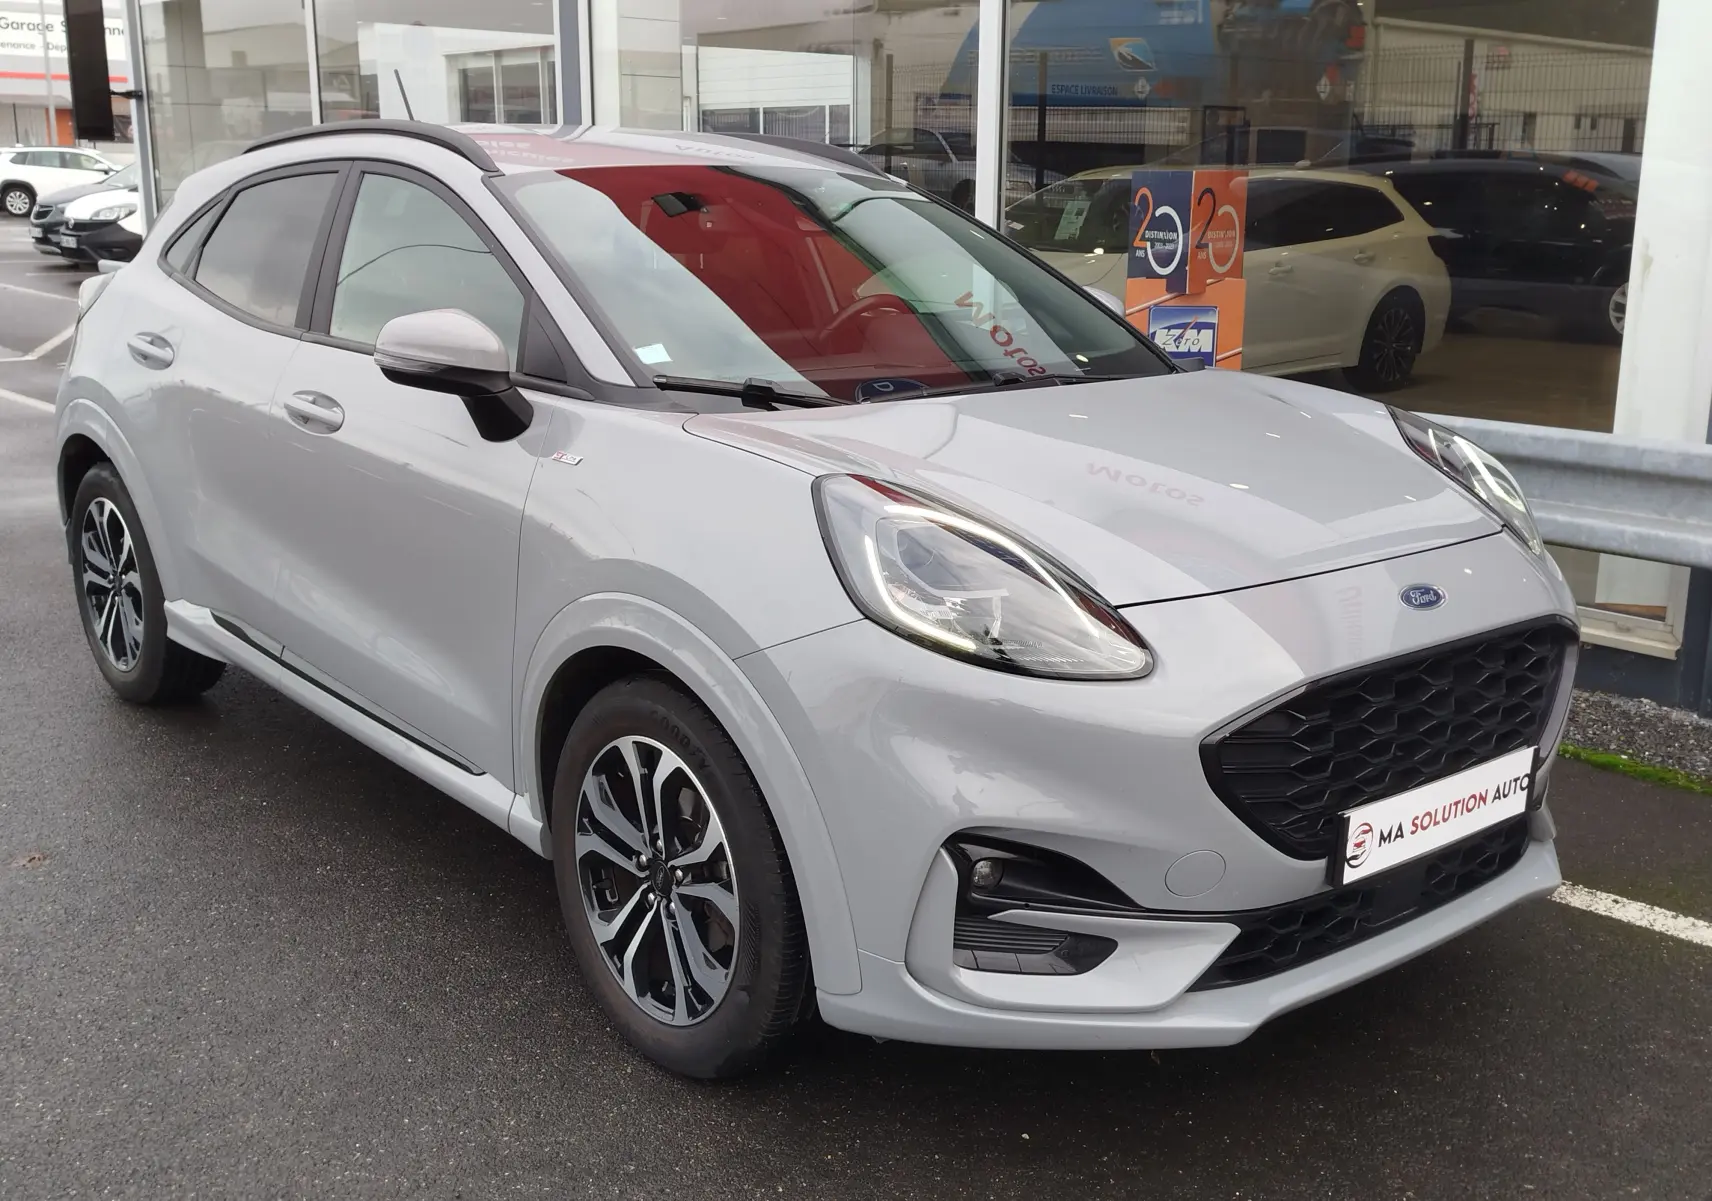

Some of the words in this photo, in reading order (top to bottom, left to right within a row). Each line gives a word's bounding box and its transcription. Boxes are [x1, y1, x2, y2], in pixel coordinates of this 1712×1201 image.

[0, 17, 54, 35] Garage
[0, 42, 36, 50] enance
[1051, 84, 1080, 95] ESPACE
[1135, 249, 1146, 258] ANS
[1409, 588, 1438, 606] Ford
[1378, 821, 1405, 848] MA
[1409, 788, 1489, 836] SOLUTION
[1491, 772, 1532, 804] AUTO
